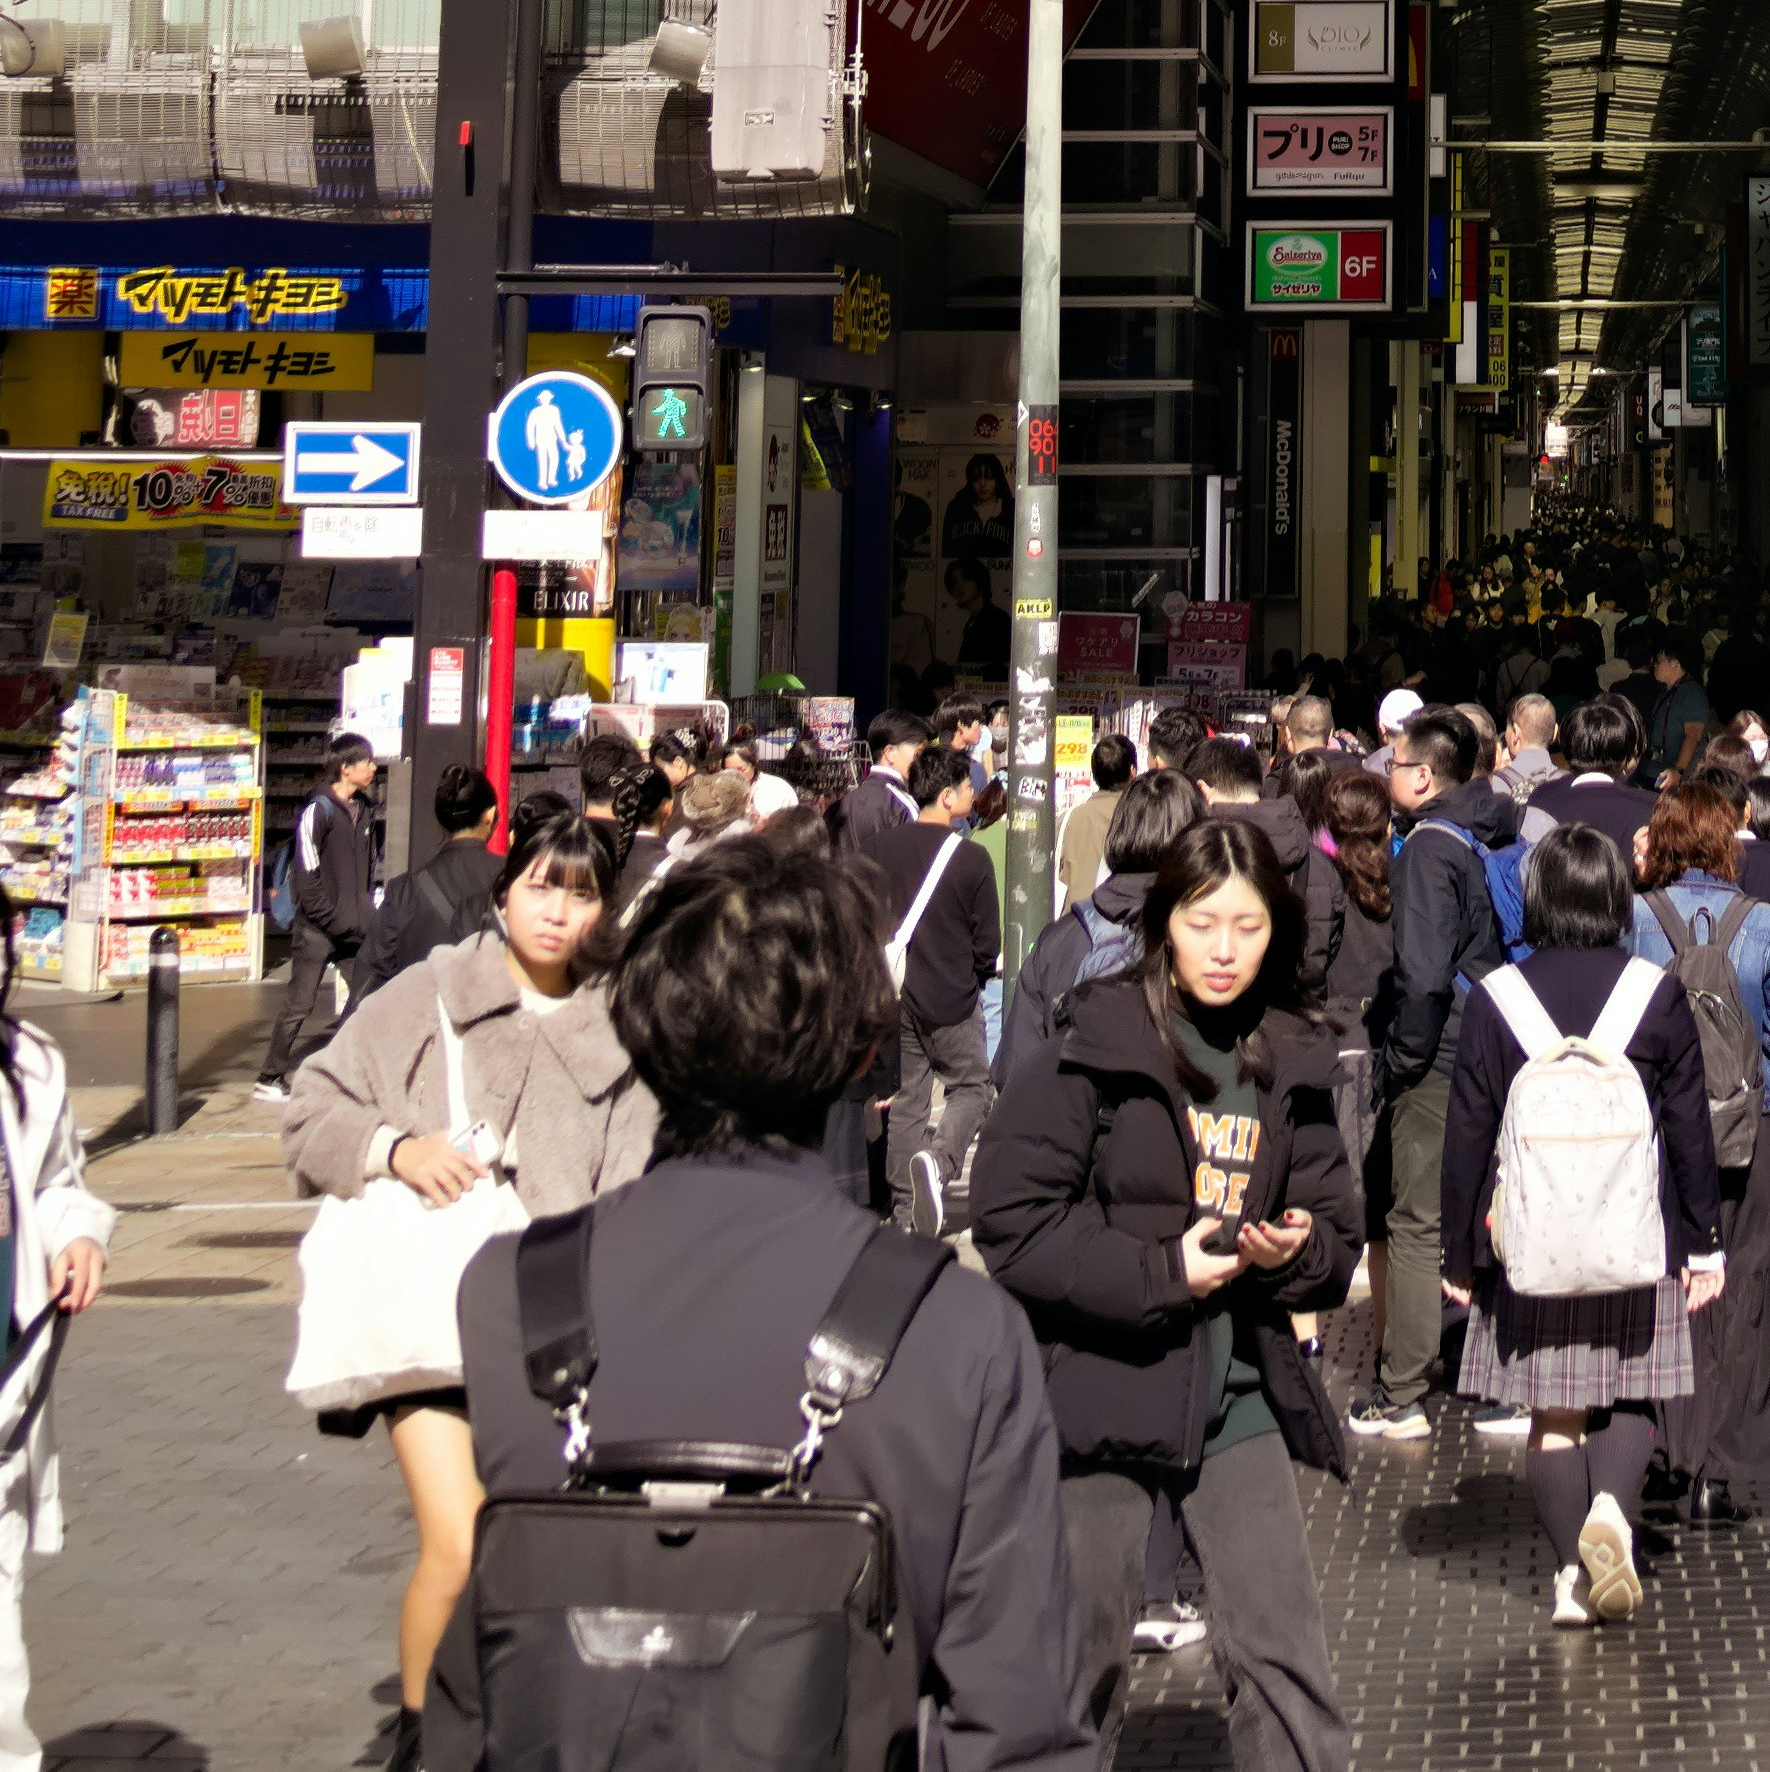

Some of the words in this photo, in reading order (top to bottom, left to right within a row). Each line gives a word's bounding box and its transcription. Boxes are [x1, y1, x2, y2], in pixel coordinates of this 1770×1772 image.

[1262, 121, 1325, 162] プリ
[1358, 126, 1378, 143] 5F
[1358, 146, 1378, 162] 7F
[1344, 256, 1378, 278] 6F
[46, 266, 99, 319] 薬
[118, 265, 348, 323] マツモトキヨシ
[1271, 282, 1322, 297] サイゼリヤ
[161, 337, 336, 385] マツモトキヨシ
[533, 589, 590, 611] ELIXIR
